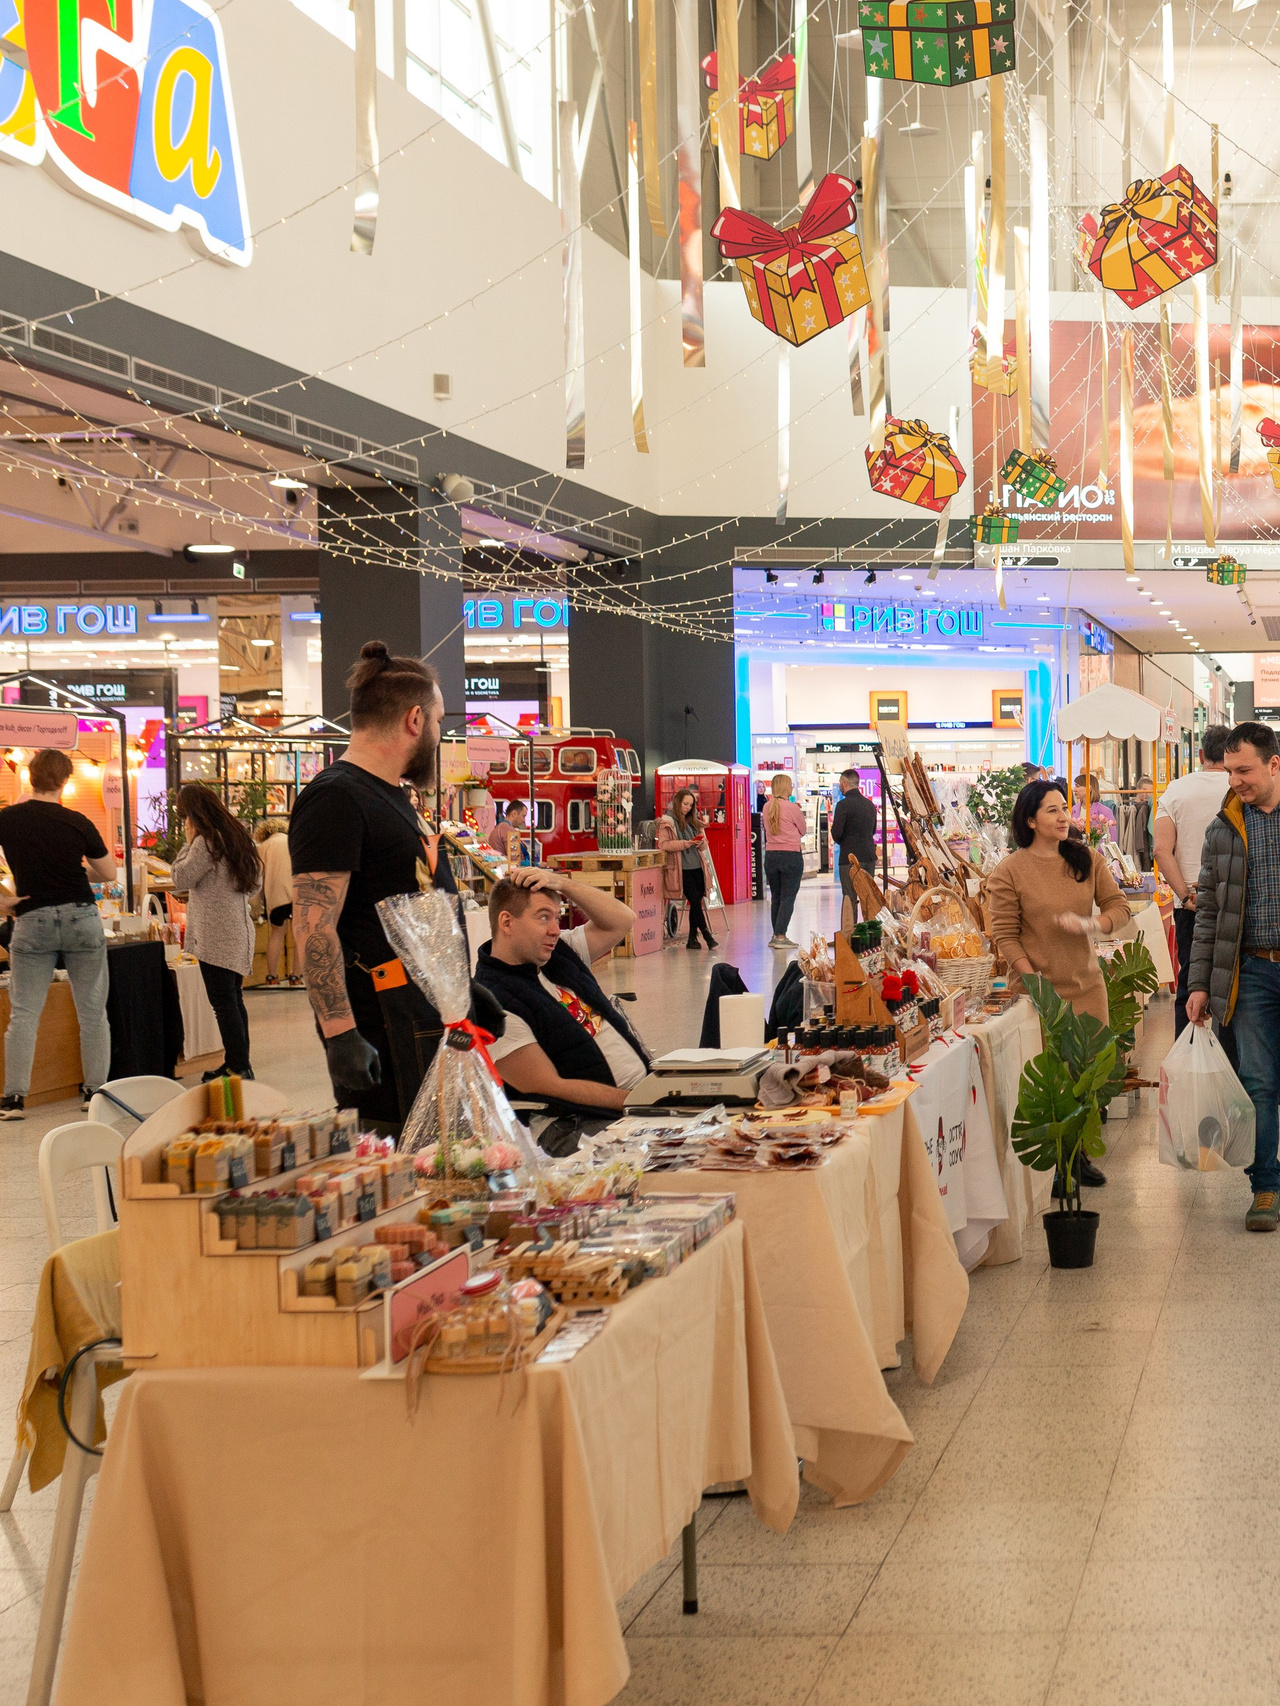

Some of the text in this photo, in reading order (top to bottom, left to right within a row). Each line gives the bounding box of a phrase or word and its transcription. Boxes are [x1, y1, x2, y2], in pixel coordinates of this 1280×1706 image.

[1002, 484, 1104, 508] ПАИО
[1063, 513, 1113, 523] ресторан
[991, 544, 1071, 555] шан Парковка
[1171, 545, 1216, 555] М.Видео
[1220, 546, 1251, 557] Леруа
[0, 604, 138, 635] ИВ ГОШ
[462, 598, 504, 629] ИВ
[852, 604, 983, 637] РИВ ГОШ
[96, 683, 126, 697] ГОШ
[471, 678, 500, 690] ГОШ
[858, 744, 874, 752] Dio
[640, 882, 655, 898] Кулёк
[638, 905, 657, 920] полный
[640, 928, 656, 942] любви
